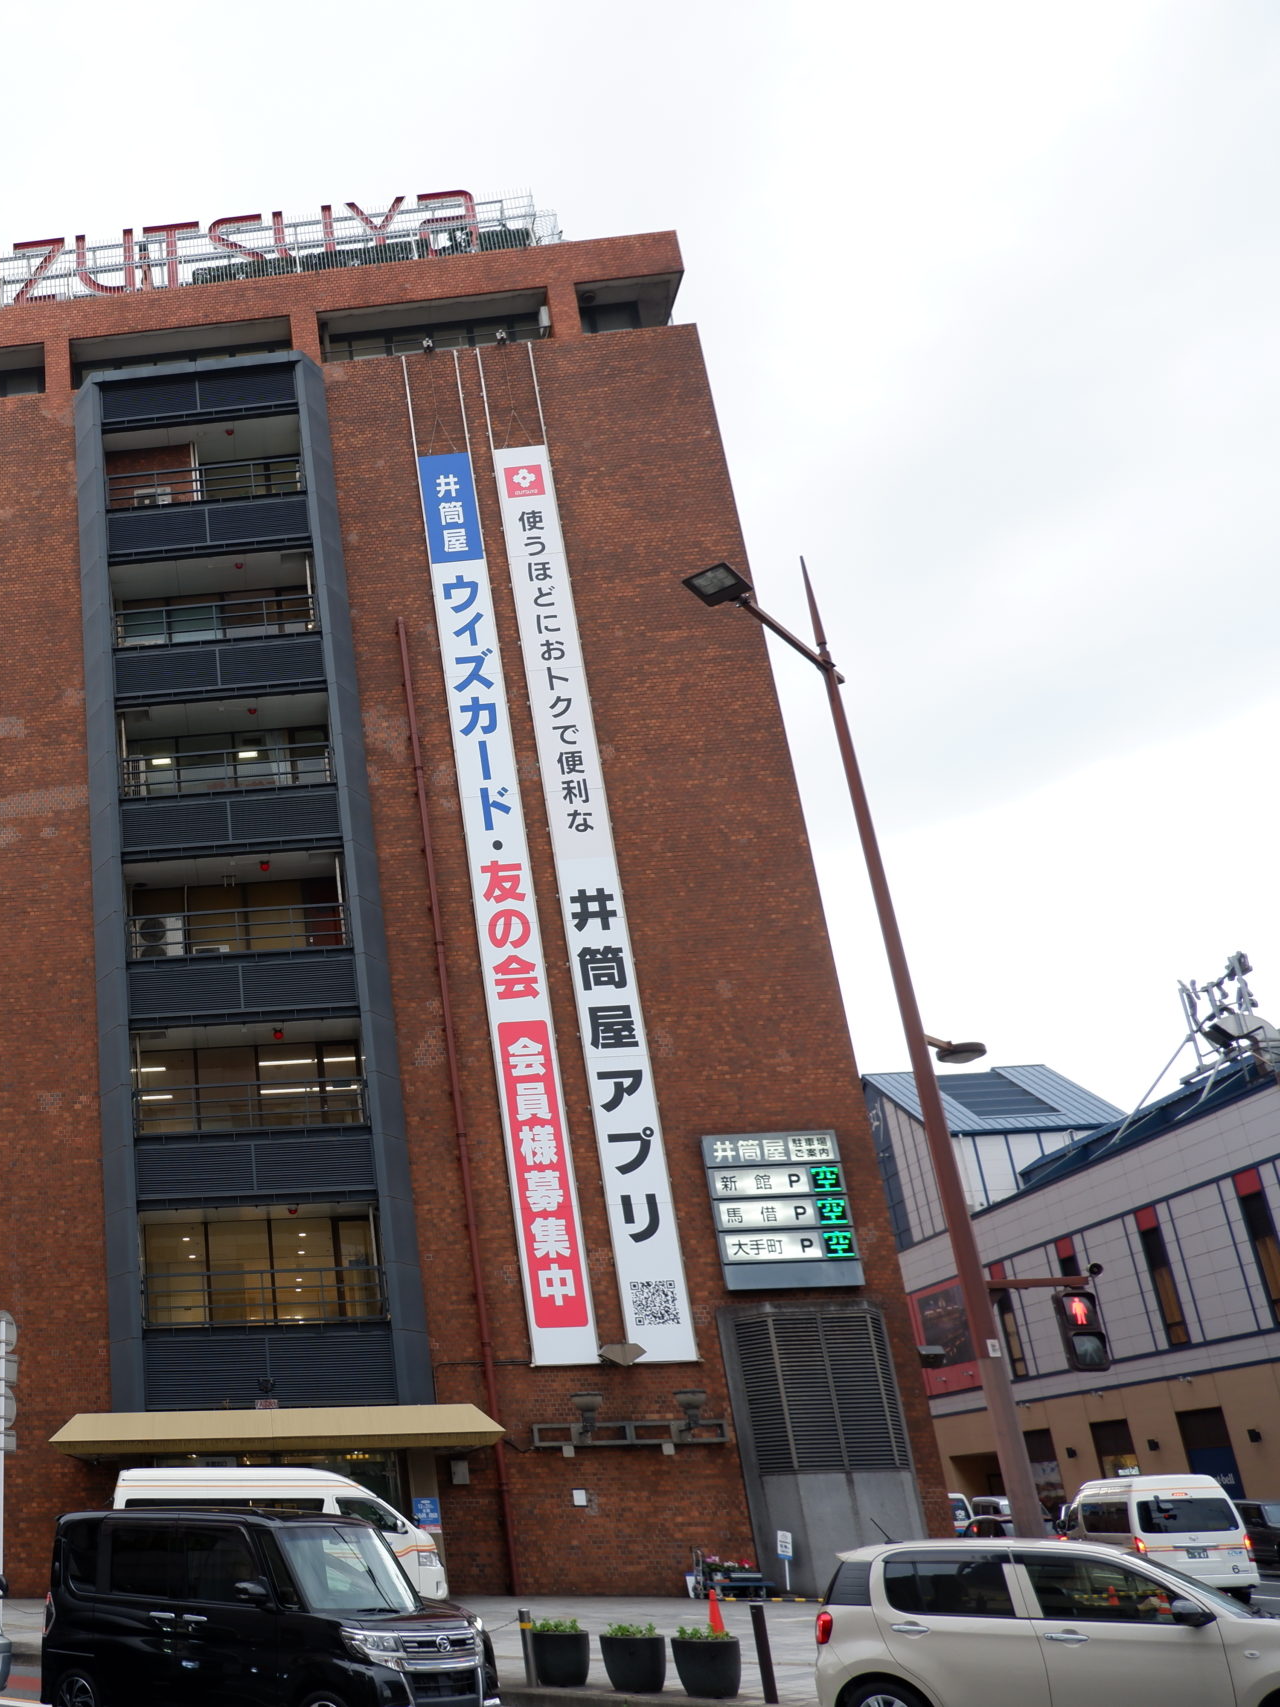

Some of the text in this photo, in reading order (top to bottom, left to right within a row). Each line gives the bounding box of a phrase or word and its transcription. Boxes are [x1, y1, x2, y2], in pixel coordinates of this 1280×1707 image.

[435, 474, 469, 553] 井筒屋
[518, 509, 594, 833] 使うほどにおトクで便利な
[570, 887, 660, 1243] 井筒屋アプリ
[713, 1139, 787, 1163] 井筒屋
[792, 1137, 827, 1148] 駐車場
[795, 1148, 830, 1158] ご案内
[507, 1036, 576, 1306] 会員様募集中
[721, 1166, 843, 1192] 新館 P 空
[726, 1198, 849, 1225] 馬借 P 空
[731, 1231, 856, 1258] 大手町 P 空
